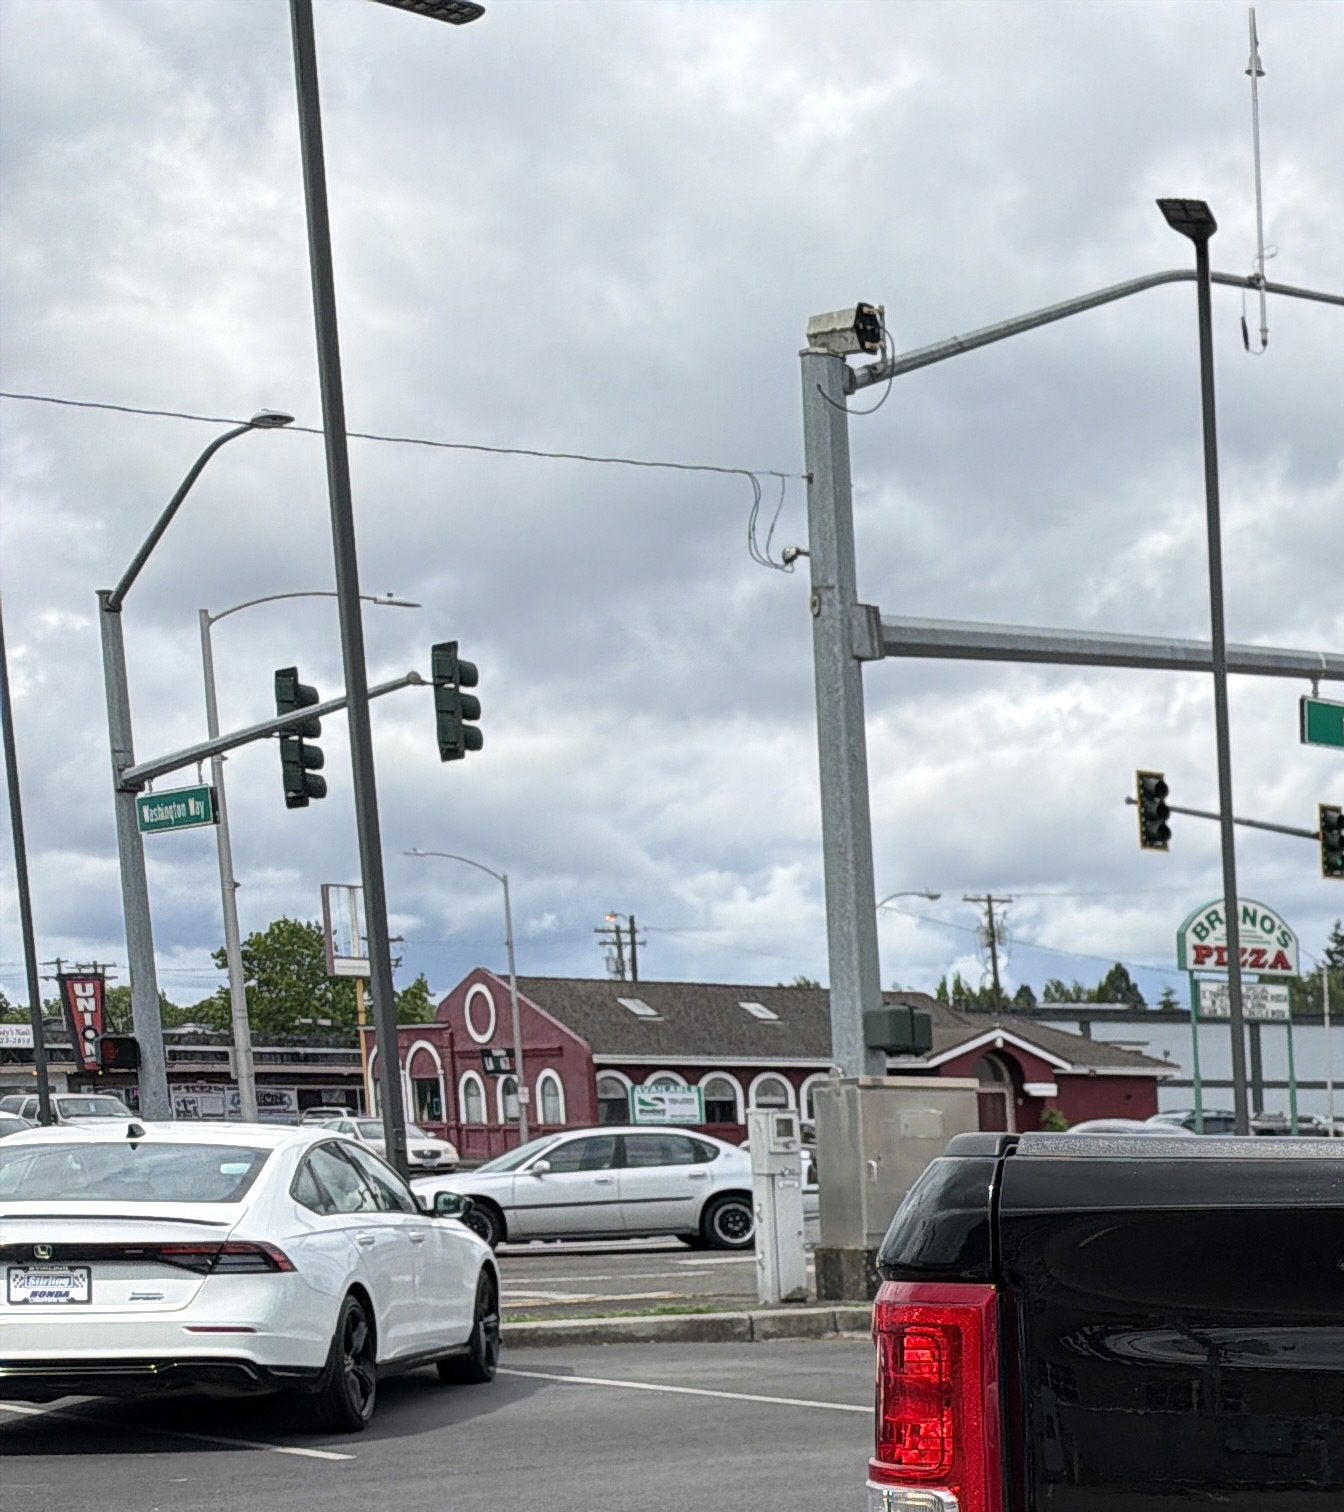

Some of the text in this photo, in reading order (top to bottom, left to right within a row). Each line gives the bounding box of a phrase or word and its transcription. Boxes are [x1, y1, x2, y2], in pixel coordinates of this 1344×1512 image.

[142, 797, 205, 825] Washington Way
[1192, 905, 1292, 949] BRNO'S
[28, 1276, 70, 1288] Stirling
